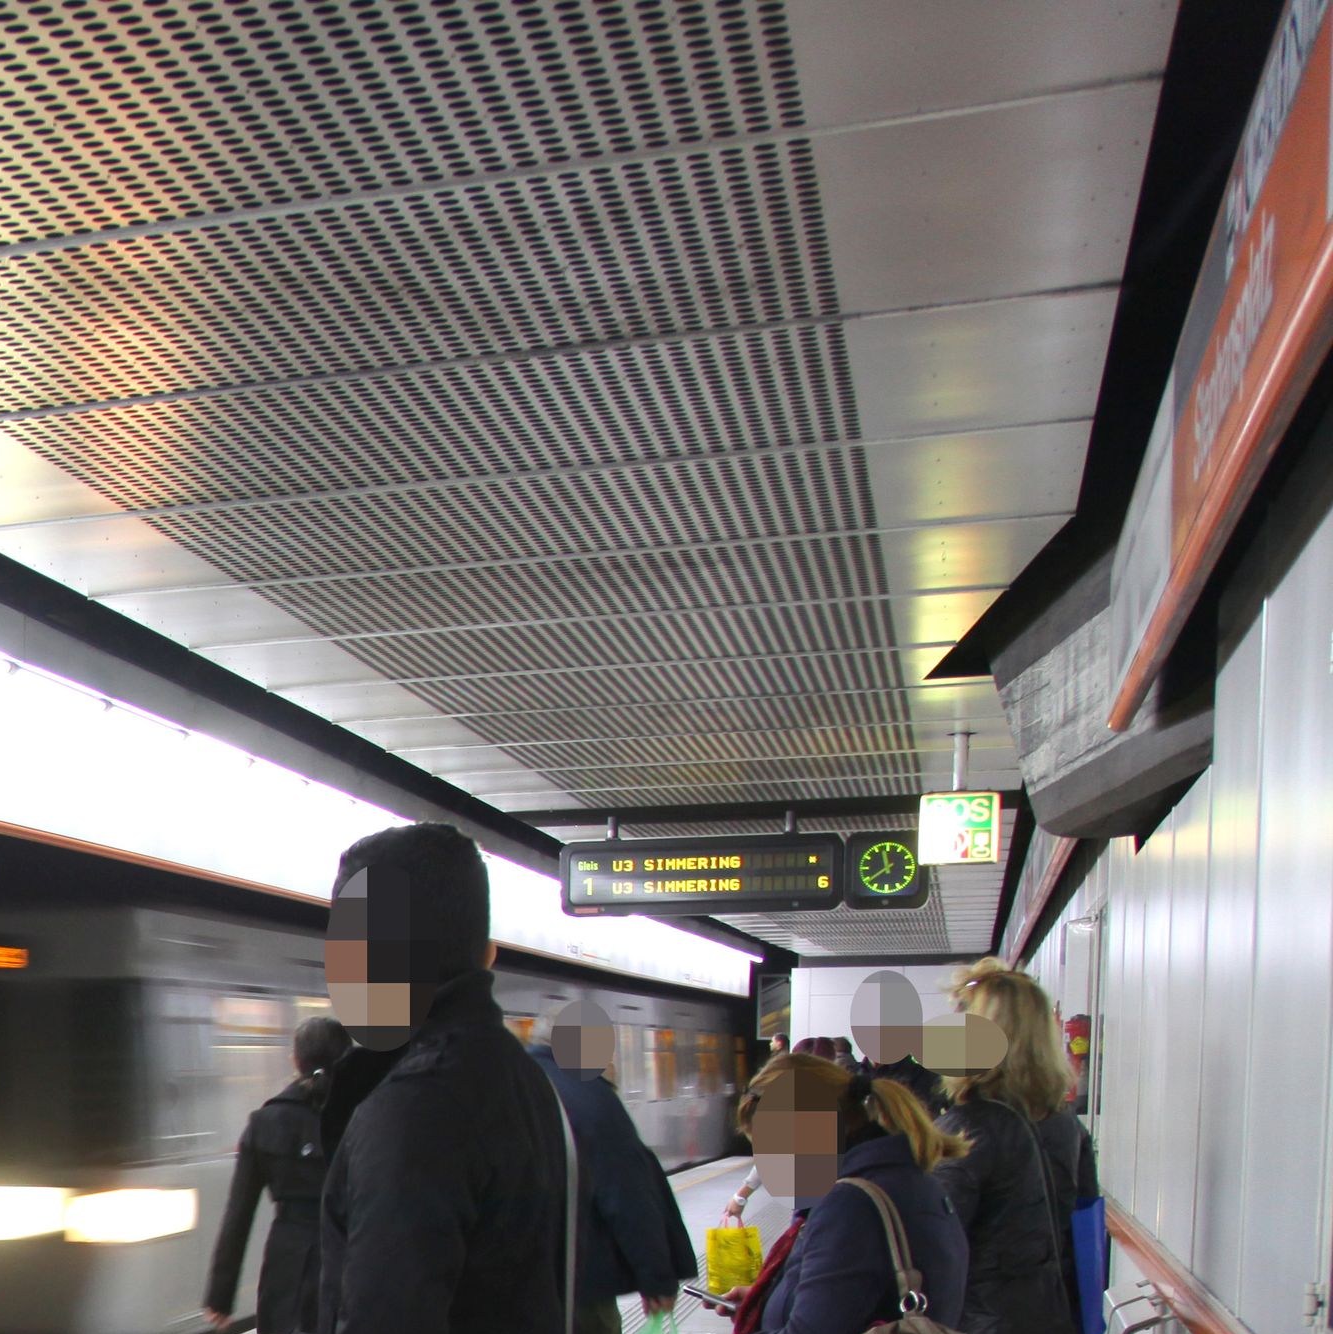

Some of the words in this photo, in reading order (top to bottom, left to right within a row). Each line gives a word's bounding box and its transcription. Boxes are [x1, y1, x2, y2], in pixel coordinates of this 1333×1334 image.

[578, 860, 598, 872] Gleis
[612, 860, 633, 872] U3
[644, 856, 741, 871] SIMMERING
[582, 877, 593, 896] 1
[612, 882, 633, 895] U3
[643, 878, 741, 894] SIMMERING
[817, 876, 829, 889] 6
